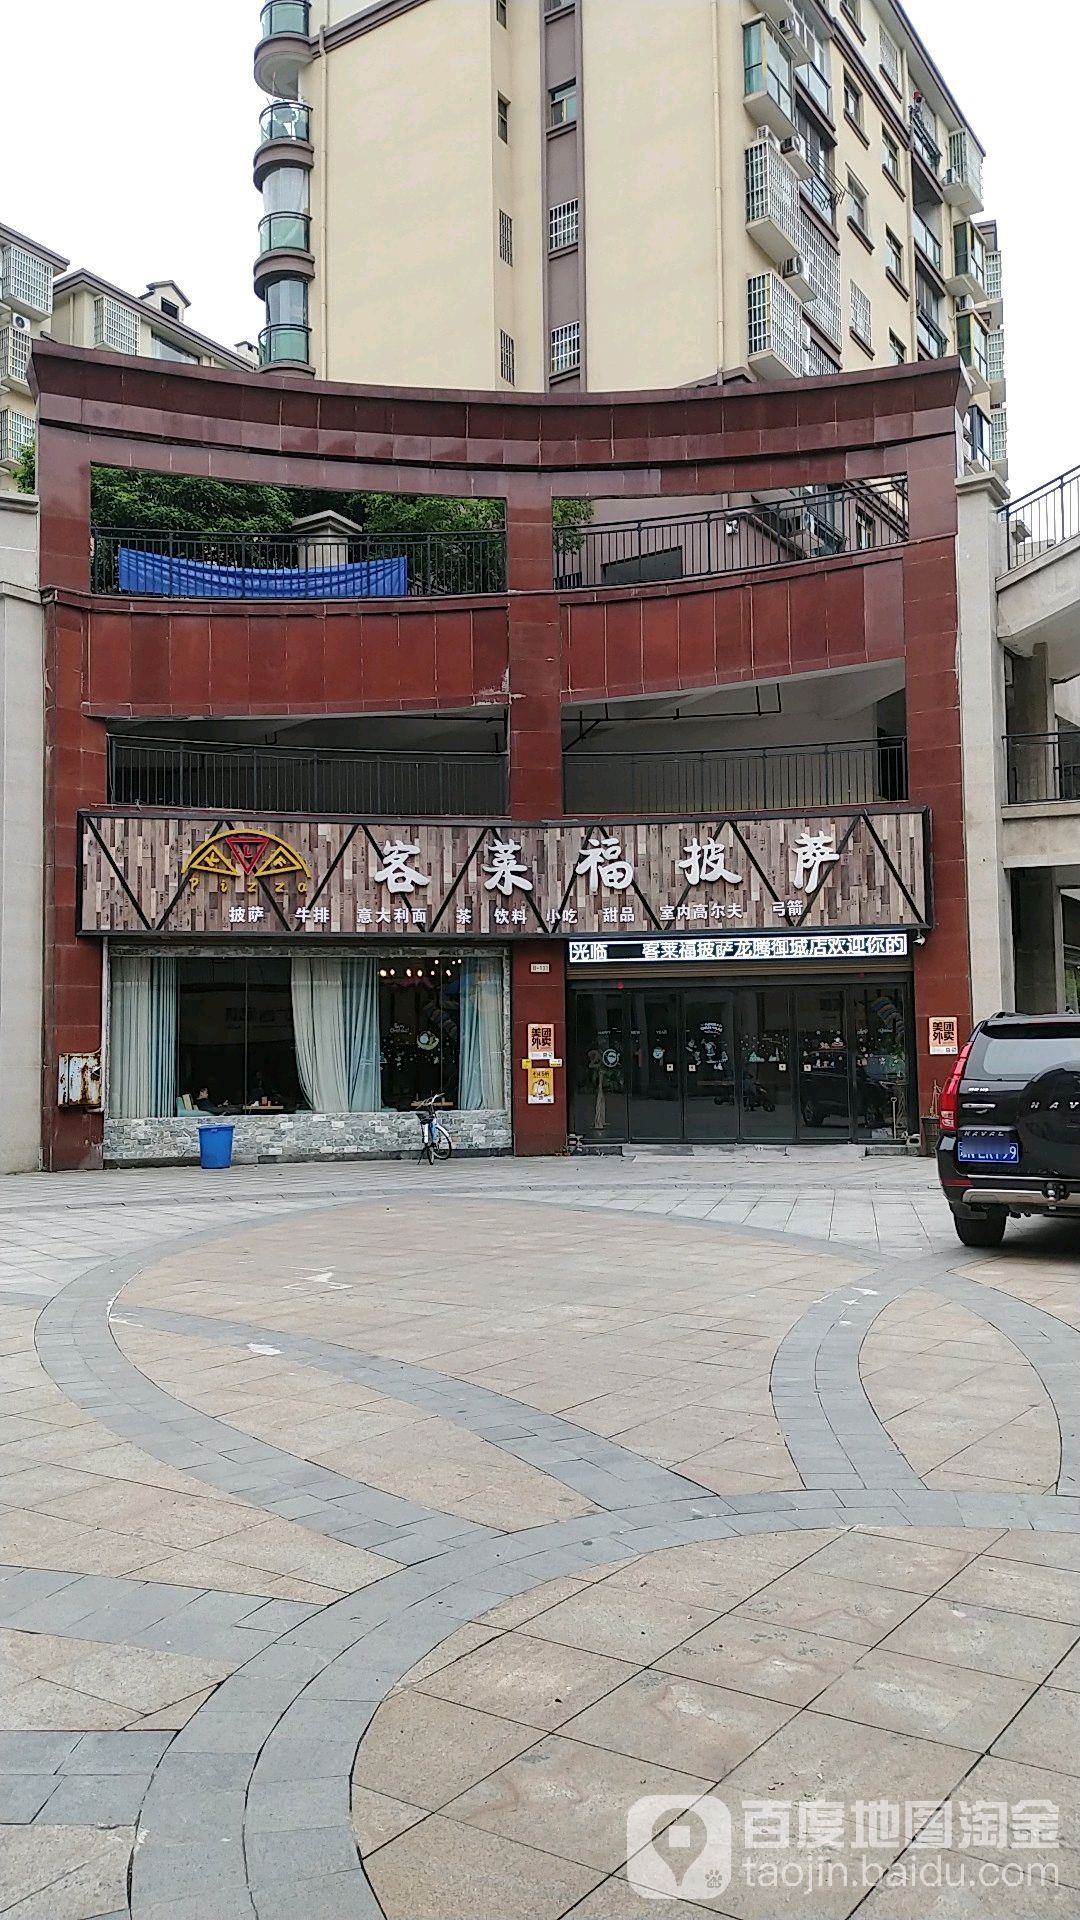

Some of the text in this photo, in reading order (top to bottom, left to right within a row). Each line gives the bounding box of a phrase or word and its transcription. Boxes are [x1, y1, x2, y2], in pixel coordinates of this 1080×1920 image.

[374, 831, 840, 895] 客莱福披萨
[229, 899, 803, 925] 披萨 牛排 意大利面 茶 饮料 小吃 甜品 室内高尔夫 弓箭
[571, 943, 608, 961] 光临
[531, 1027, 552, 1038] 美团
[932, 1021, 955, 1031] 美团
[531, 1036, 552, 1049] 外卖
[932, 1031, 955, 1045] 外卖
